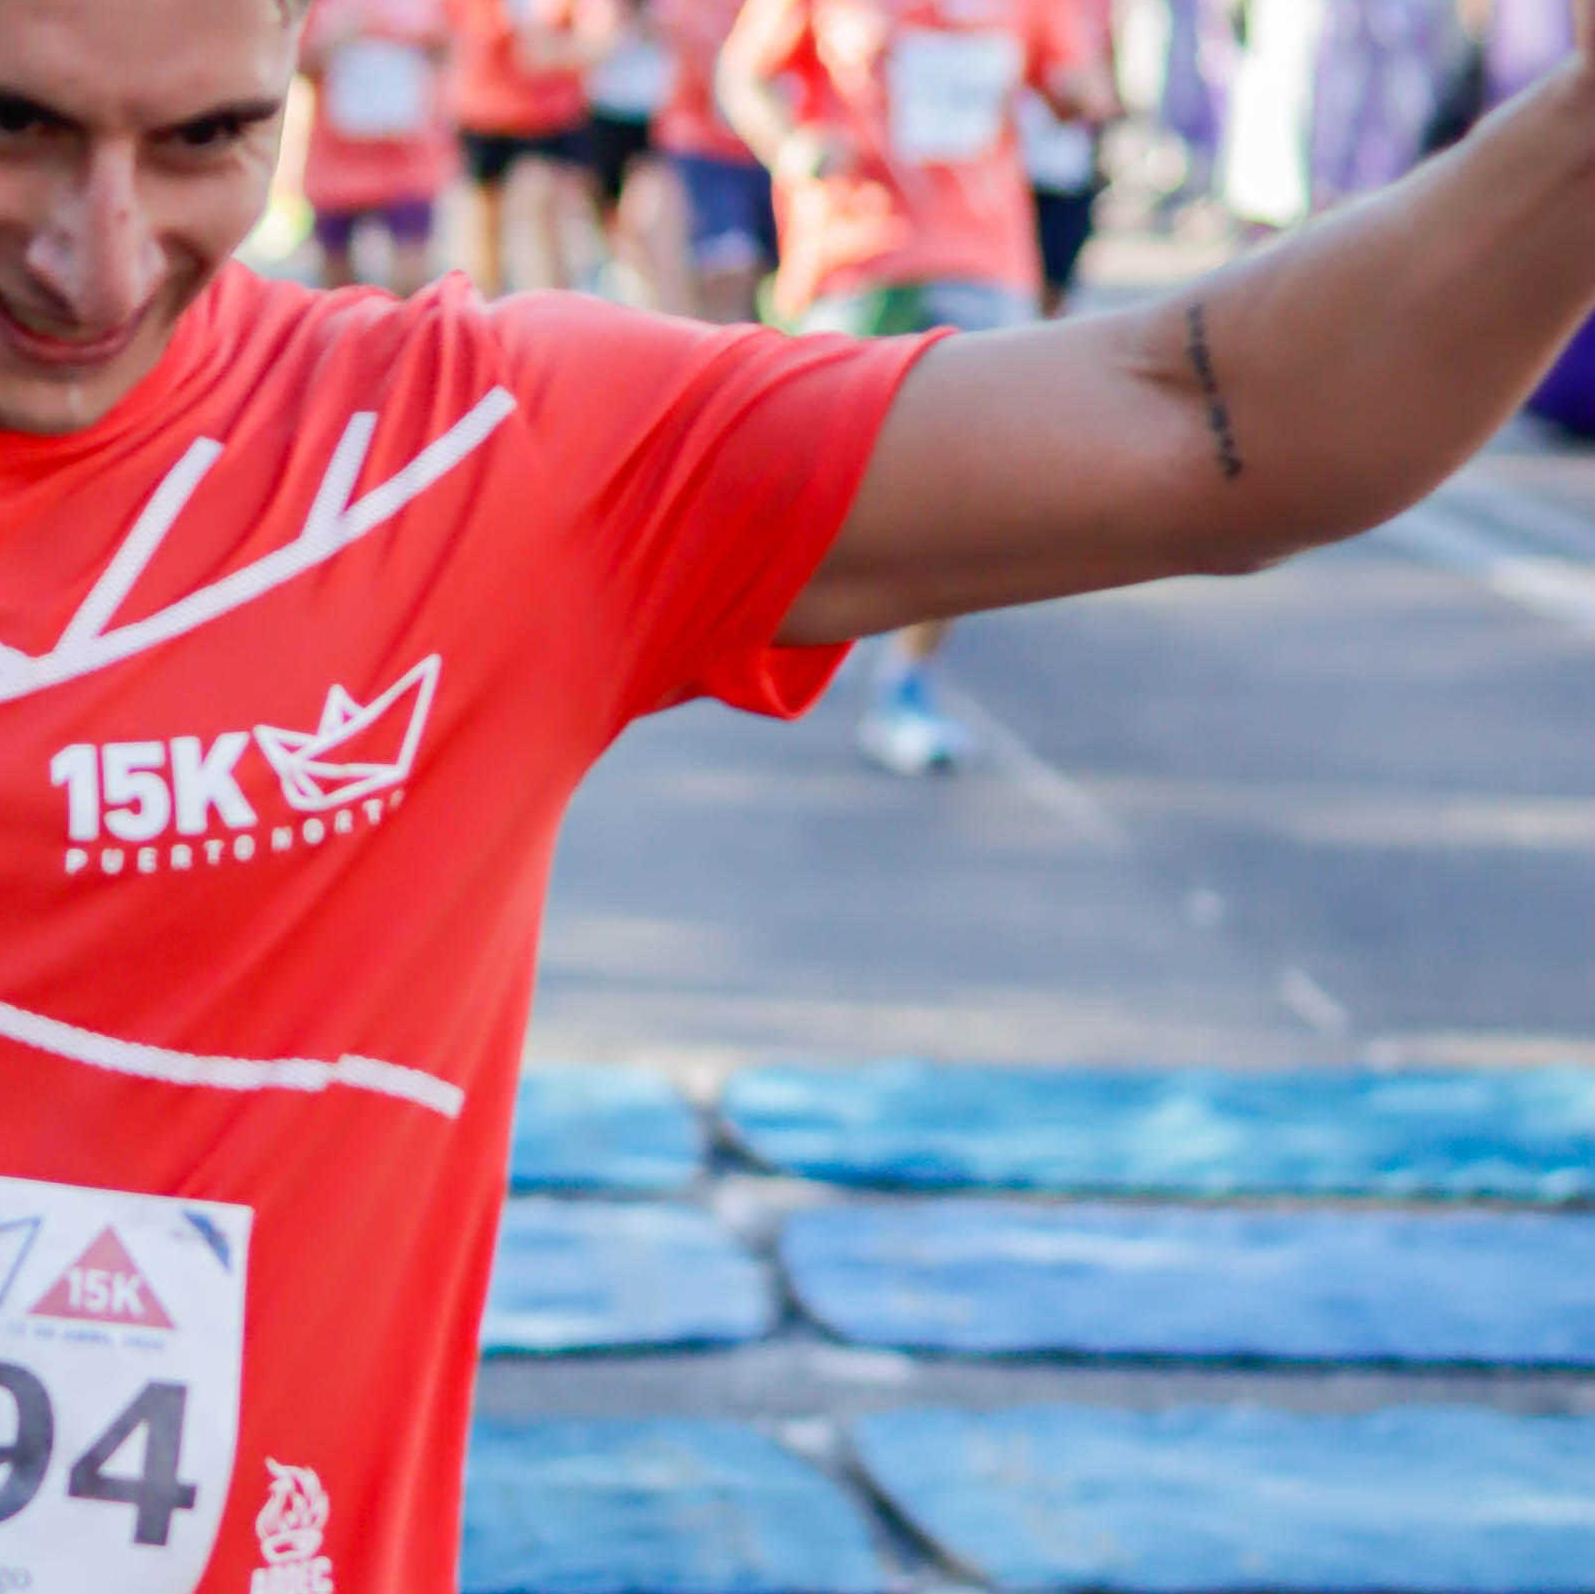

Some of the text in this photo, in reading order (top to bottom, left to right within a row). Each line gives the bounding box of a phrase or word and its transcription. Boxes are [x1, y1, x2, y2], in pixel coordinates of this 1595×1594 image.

[49, 731, 258, 842] 15K
[65, 834, 256, 875] PUERTO
[65, 1269, 149, 1317] 15K
